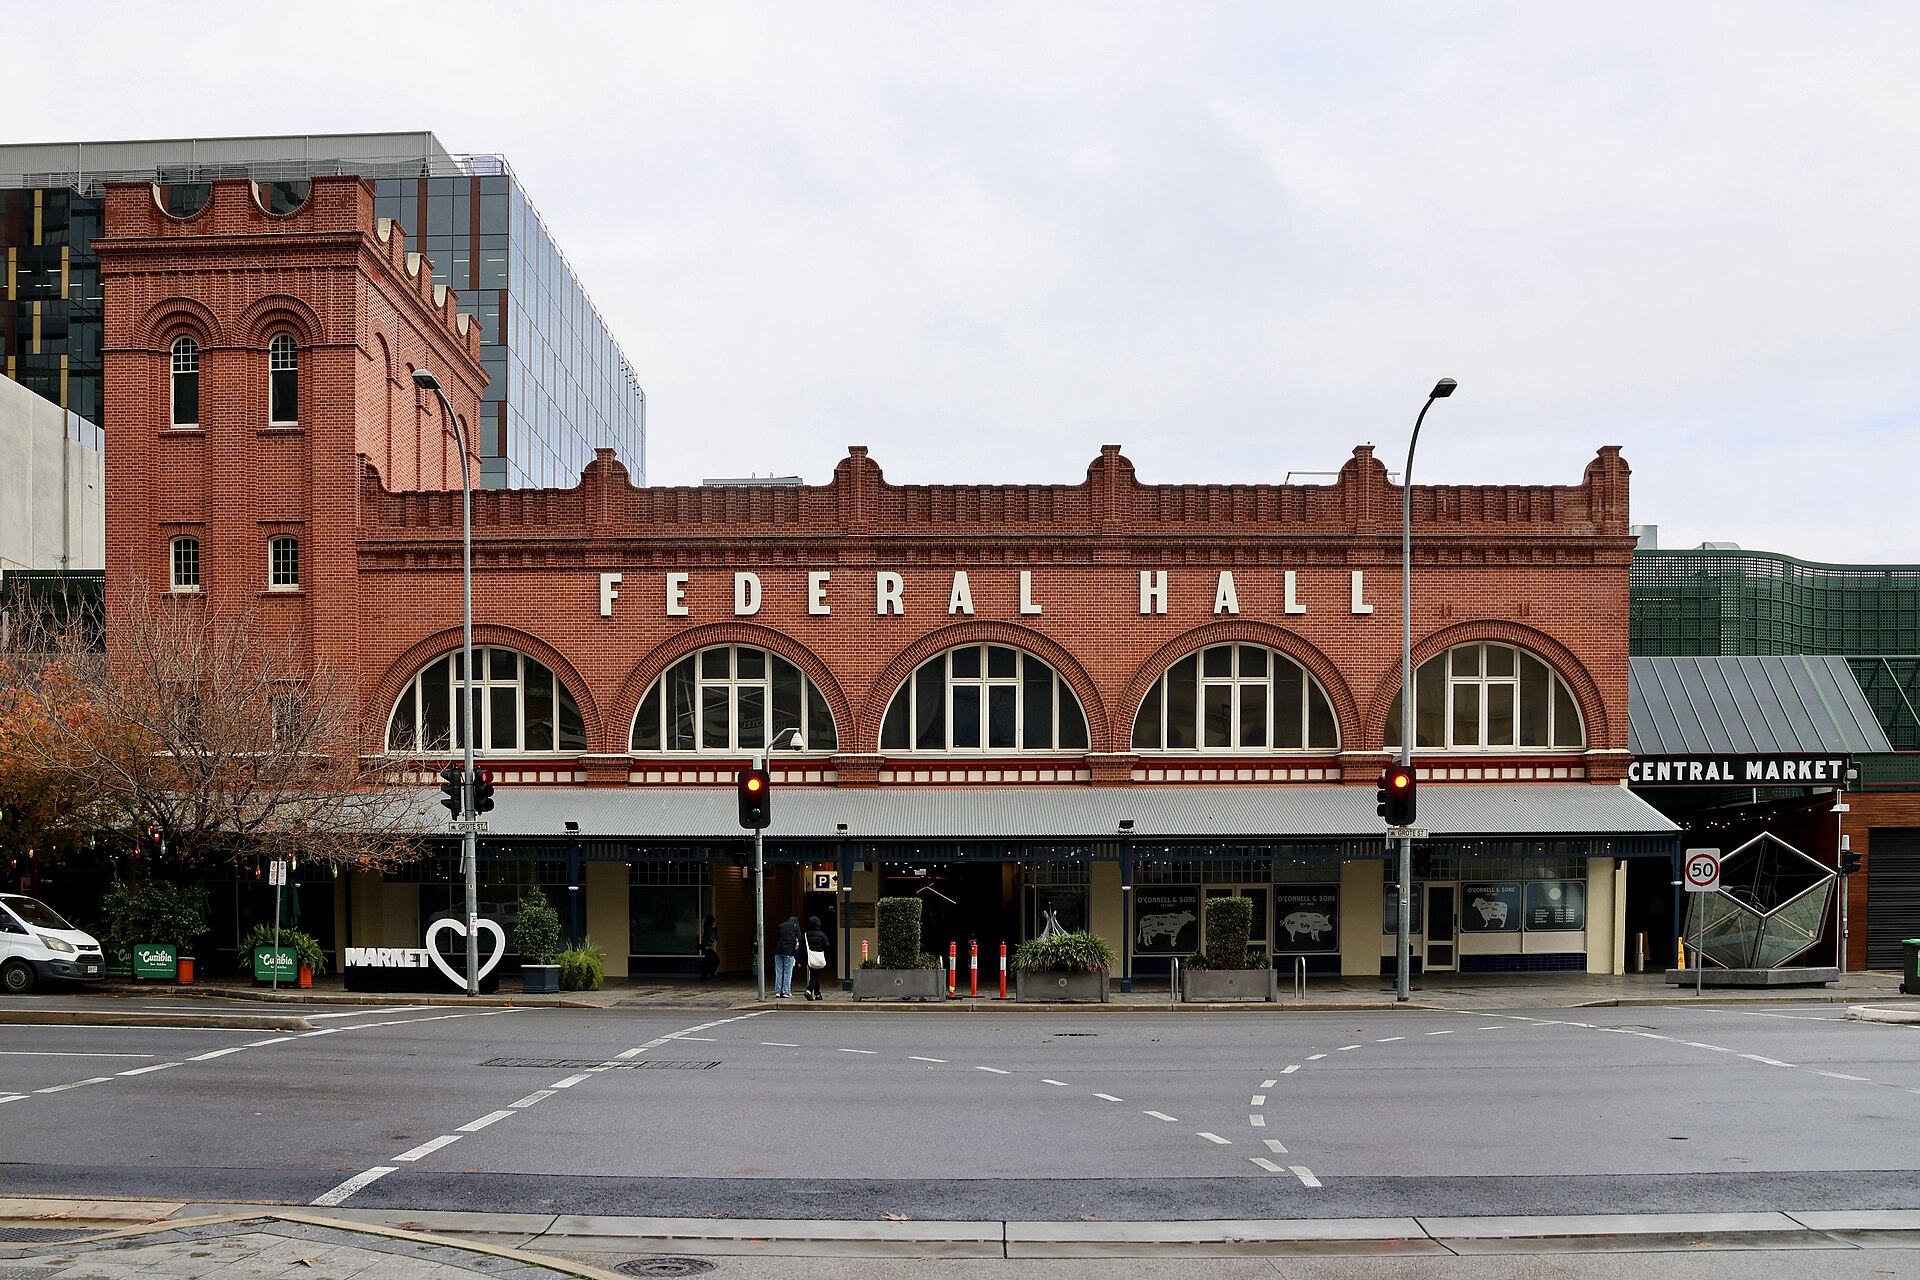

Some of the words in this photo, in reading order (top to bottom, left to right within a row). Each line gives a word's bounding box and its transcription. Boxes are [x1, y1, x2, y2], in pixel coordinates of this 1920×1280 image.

[599, 570, 1043, 617] FEDERAL
[1139, 570, 1374, 615] HALL
[1628, 761, 1735, 782] CENTRAL
[1746, 760, 1843, 780] MARKET
[1691, 862, 1714, 878] 50
[818, 876, 827, 887] P
[1137, 896, 1171, 904] O'CONNELL
[138, 950, 172, 963] Cumbia
[344, 947, 429, 968] MARKET
